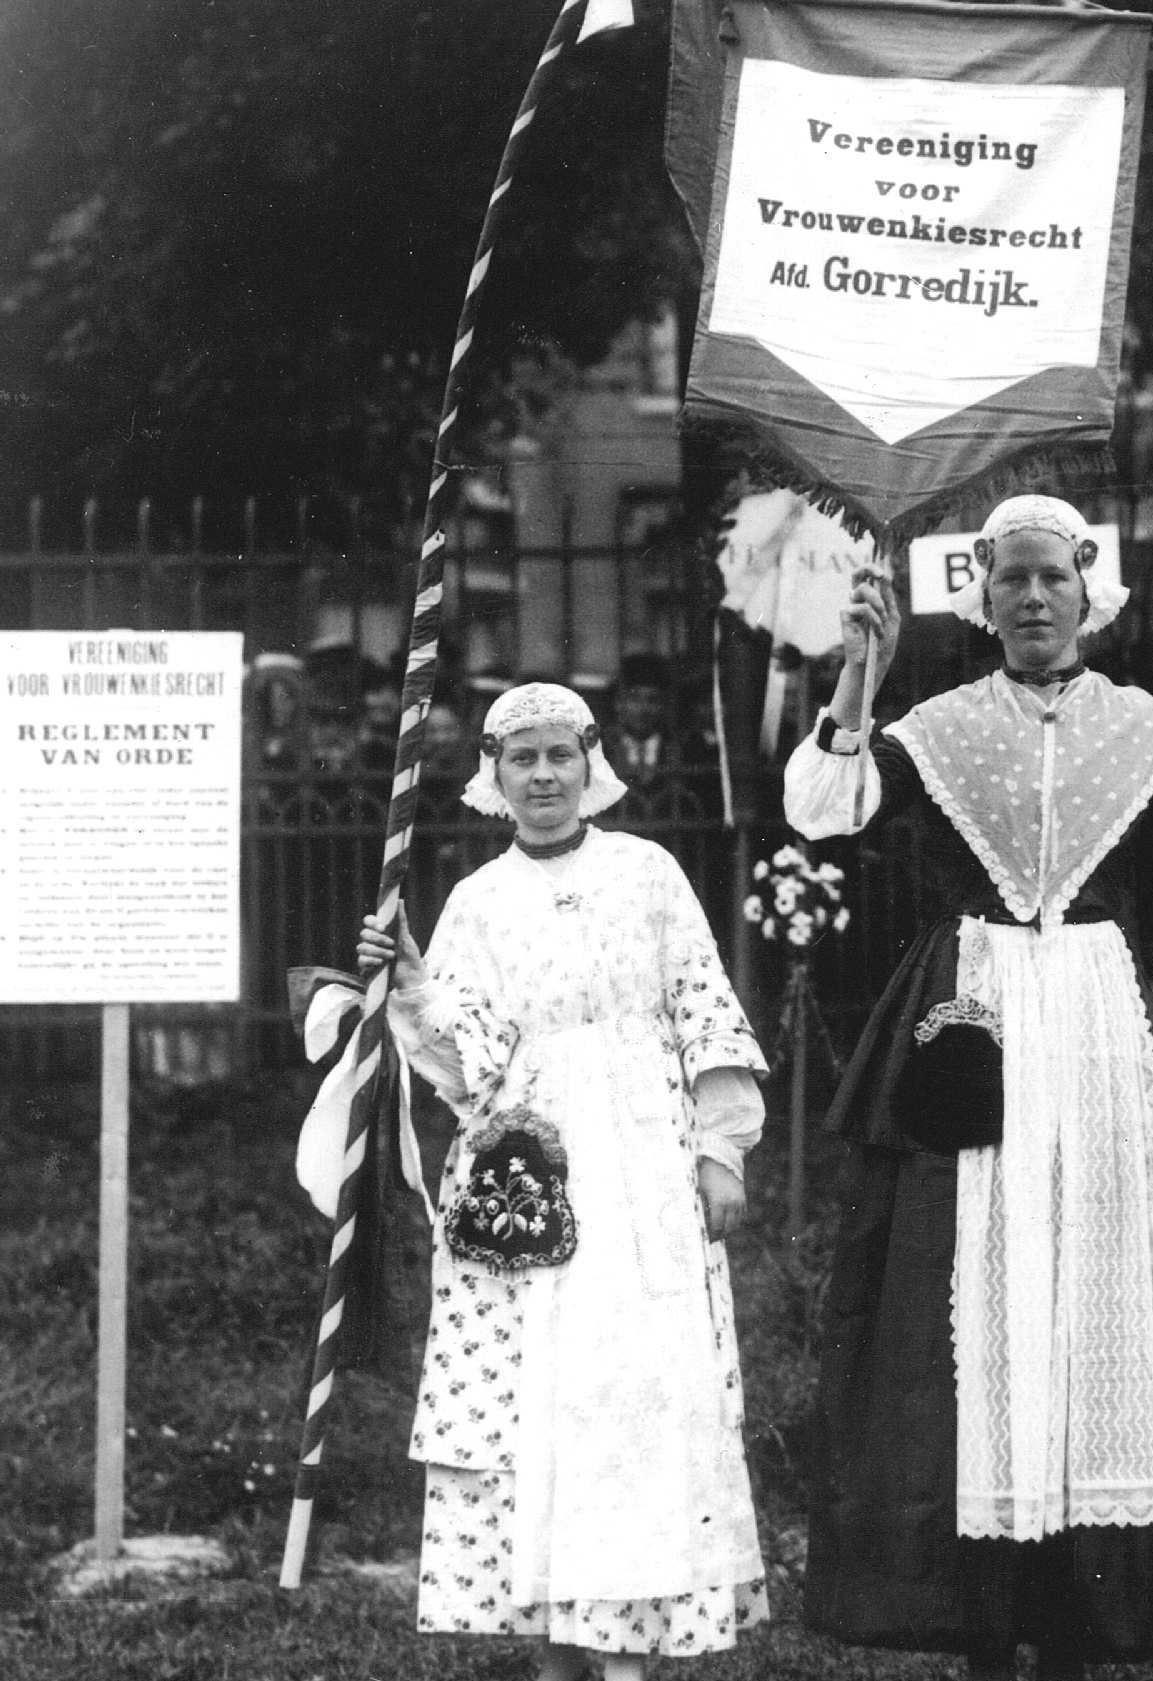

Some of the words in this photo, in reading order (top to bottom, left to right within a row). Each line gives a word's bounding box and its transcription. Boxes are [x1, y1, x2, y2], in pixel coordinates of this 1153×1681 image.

[807, 118, 1038, 169] Vereeniging
[875, 180, 960, 203] voor
[757, 198, 1084, 250] Vrouwenkiesrecht
[769, 260, 811, 289] Afd.
[823, 255, 1038, 317] Gorredijk.
[69, 639, 168, 665] VEREENIGING
[7, 672, 50, 697] VOOR
[62, 671, 225, 697] VROUWENKIESRECHT
[18, 723, 215, 741] REGLEMENT
[40, 748, 100, 765] VAN
[116, 748, 193, 765] ORDE
